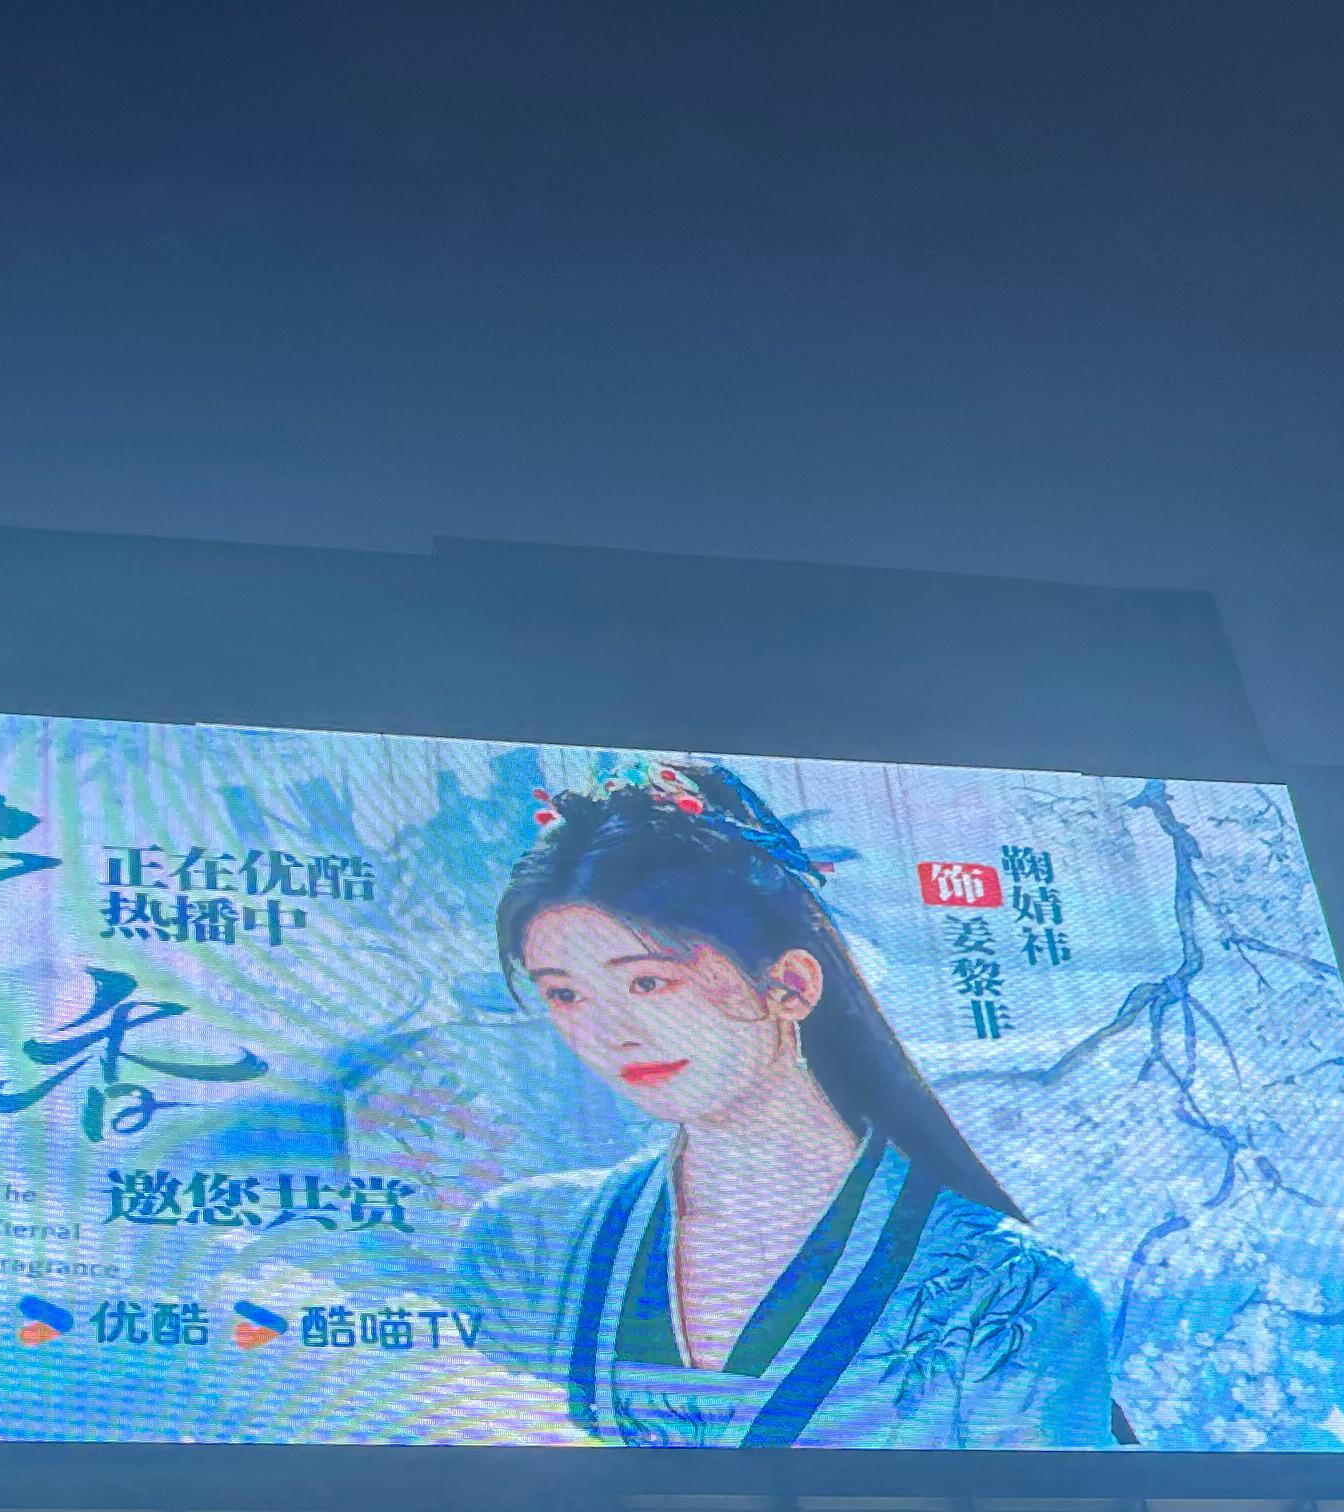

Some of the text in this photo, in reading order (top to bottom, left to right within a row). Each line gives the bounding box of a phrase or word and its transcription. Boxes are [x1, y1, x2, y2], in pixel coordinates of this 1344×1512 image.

[97, 845, 375, 901] 正在优酷
[931, 863, 984, 904] 饰
[99, 891, 306, 946] 热播中
[1001, 845, 1071, 966] 鞠婧祎
[942, 913, 1016, 1039] 姜黎非
[102, 1168, 416, 1234] 邀您共赏
[89, 1300, 209, 1347] 优酷
[301, 1305, 483, 1350] 酷喵TV
